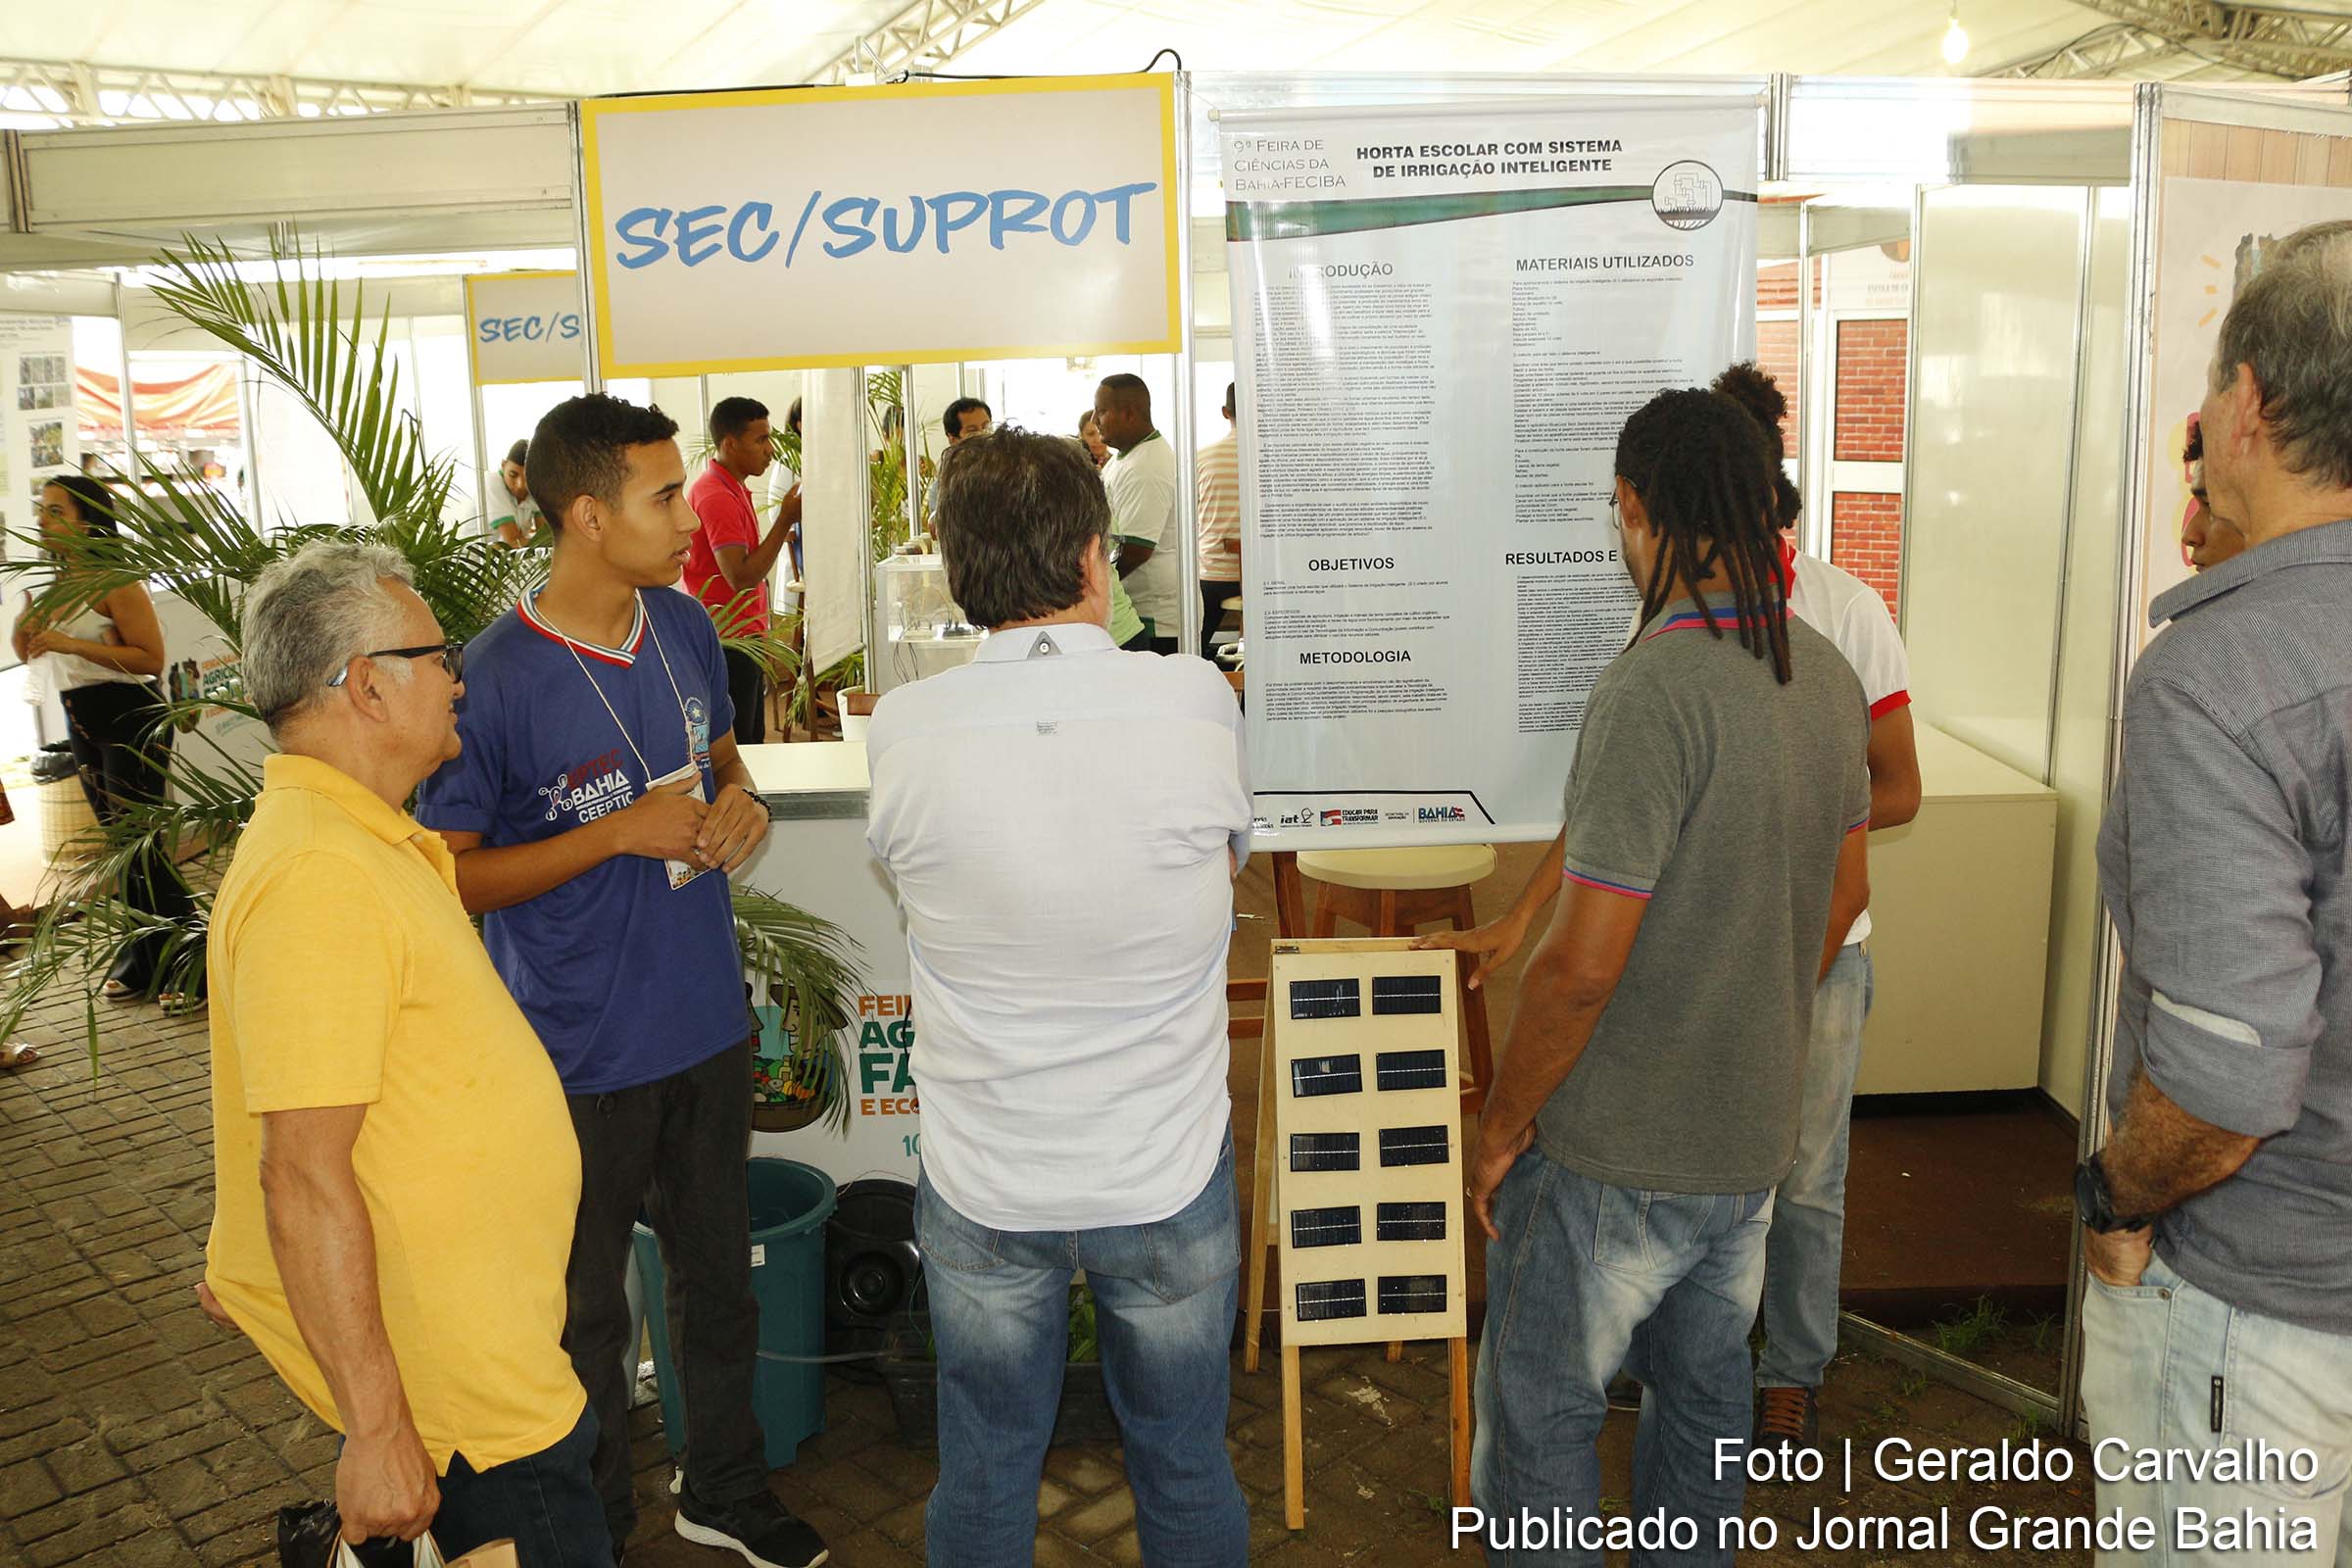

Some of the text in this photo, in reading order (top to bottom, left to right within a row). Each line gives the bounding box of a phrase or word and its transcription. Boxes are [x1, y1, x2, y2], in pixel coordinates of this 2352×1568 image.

[1256, 140, 1300, 152] FEIRA
[1303, 139, 1324, 150] DE
[1356, 139, 1623, 159] HORTA ESCOLAR COM SISTEMA
[1308, 159, 1330, 170] DA
[1373, 159, 1612, 178] DE IRRIGAÇÃO INTELIGENTE
[615, 182, 1158, 270] SEC/SUPROT
[1516, 254, 1694, 271] MATERIAIS UTILIZADOS
[1308, 557, 1395, 571] OBJETIVOS
[1505, 550, 1618, 564] RESULTADOS E
[1299, 650, 1412, 664] METODOLOGIA
[571, 768, 629, 807] BAHIA
[578, 791, 635, 824] CEEPTIC
[1418, 807, 1460, 819] BAHIA
[1280, 814, 1299, 824] iat
[860, 1098, 876, 1116] E
